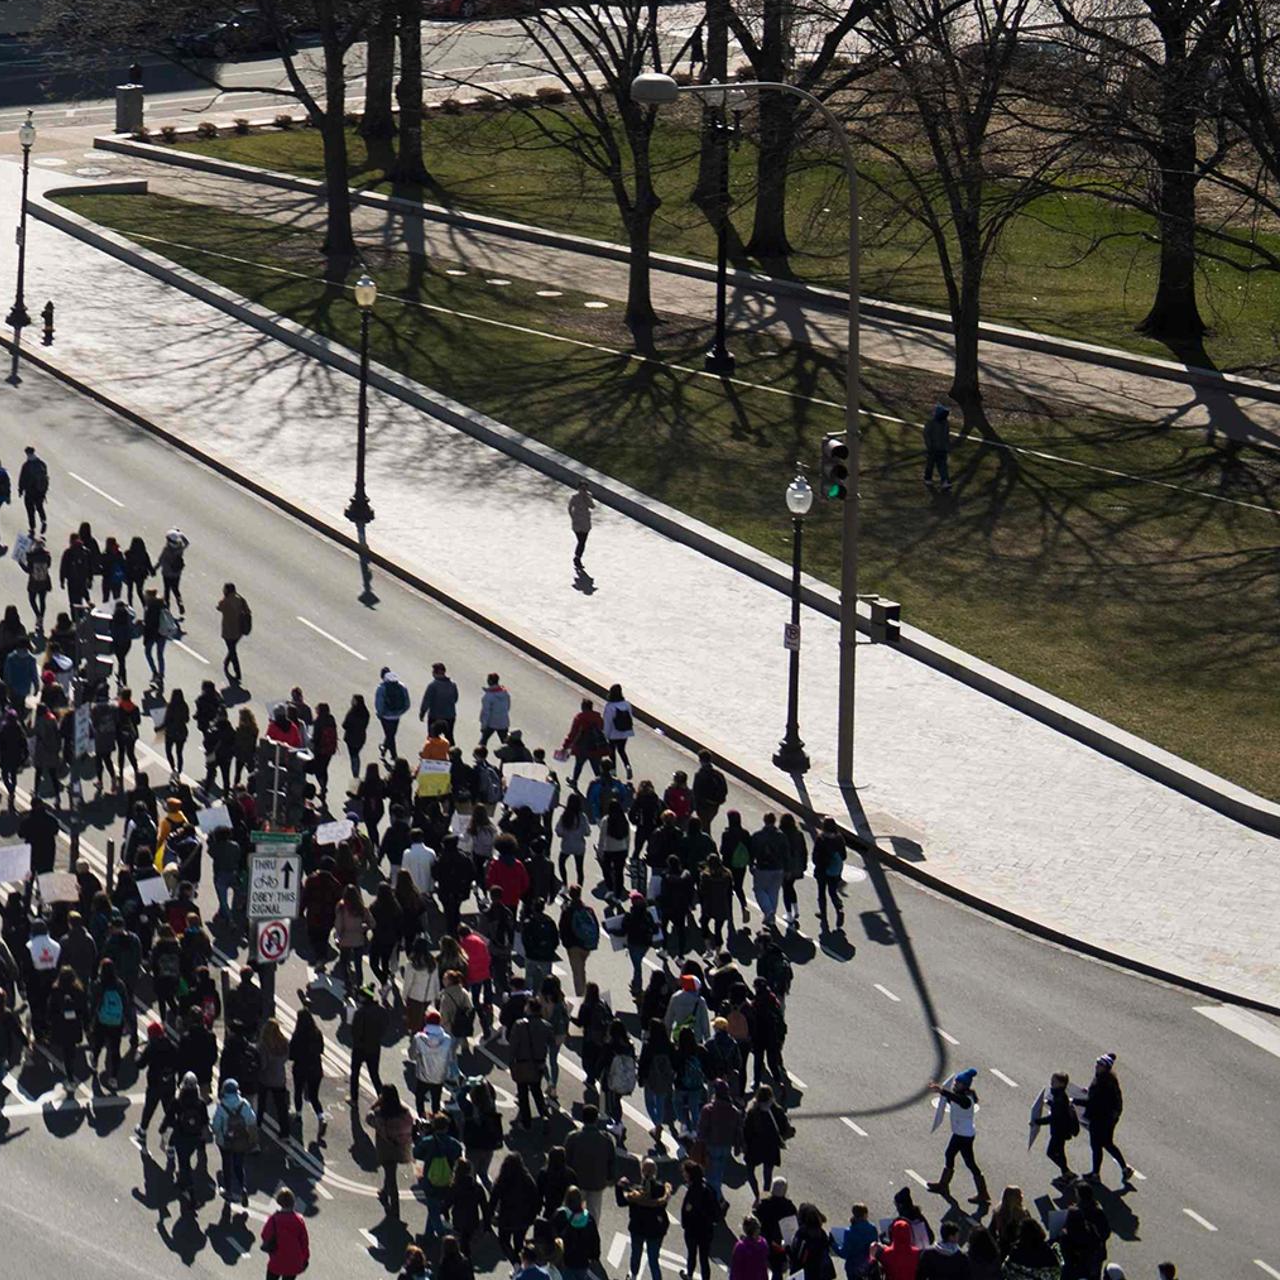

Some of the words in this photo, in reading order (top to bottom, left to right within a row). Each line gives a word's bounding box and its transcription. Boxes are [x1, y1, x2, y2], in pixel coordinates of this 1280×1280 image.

[255, 859, 277, 870] THRU
[252, 891, 273, 902] OBEY
[277, 891, 297, 902] THIS
[251, 903, 282, 914] SIGNAL
